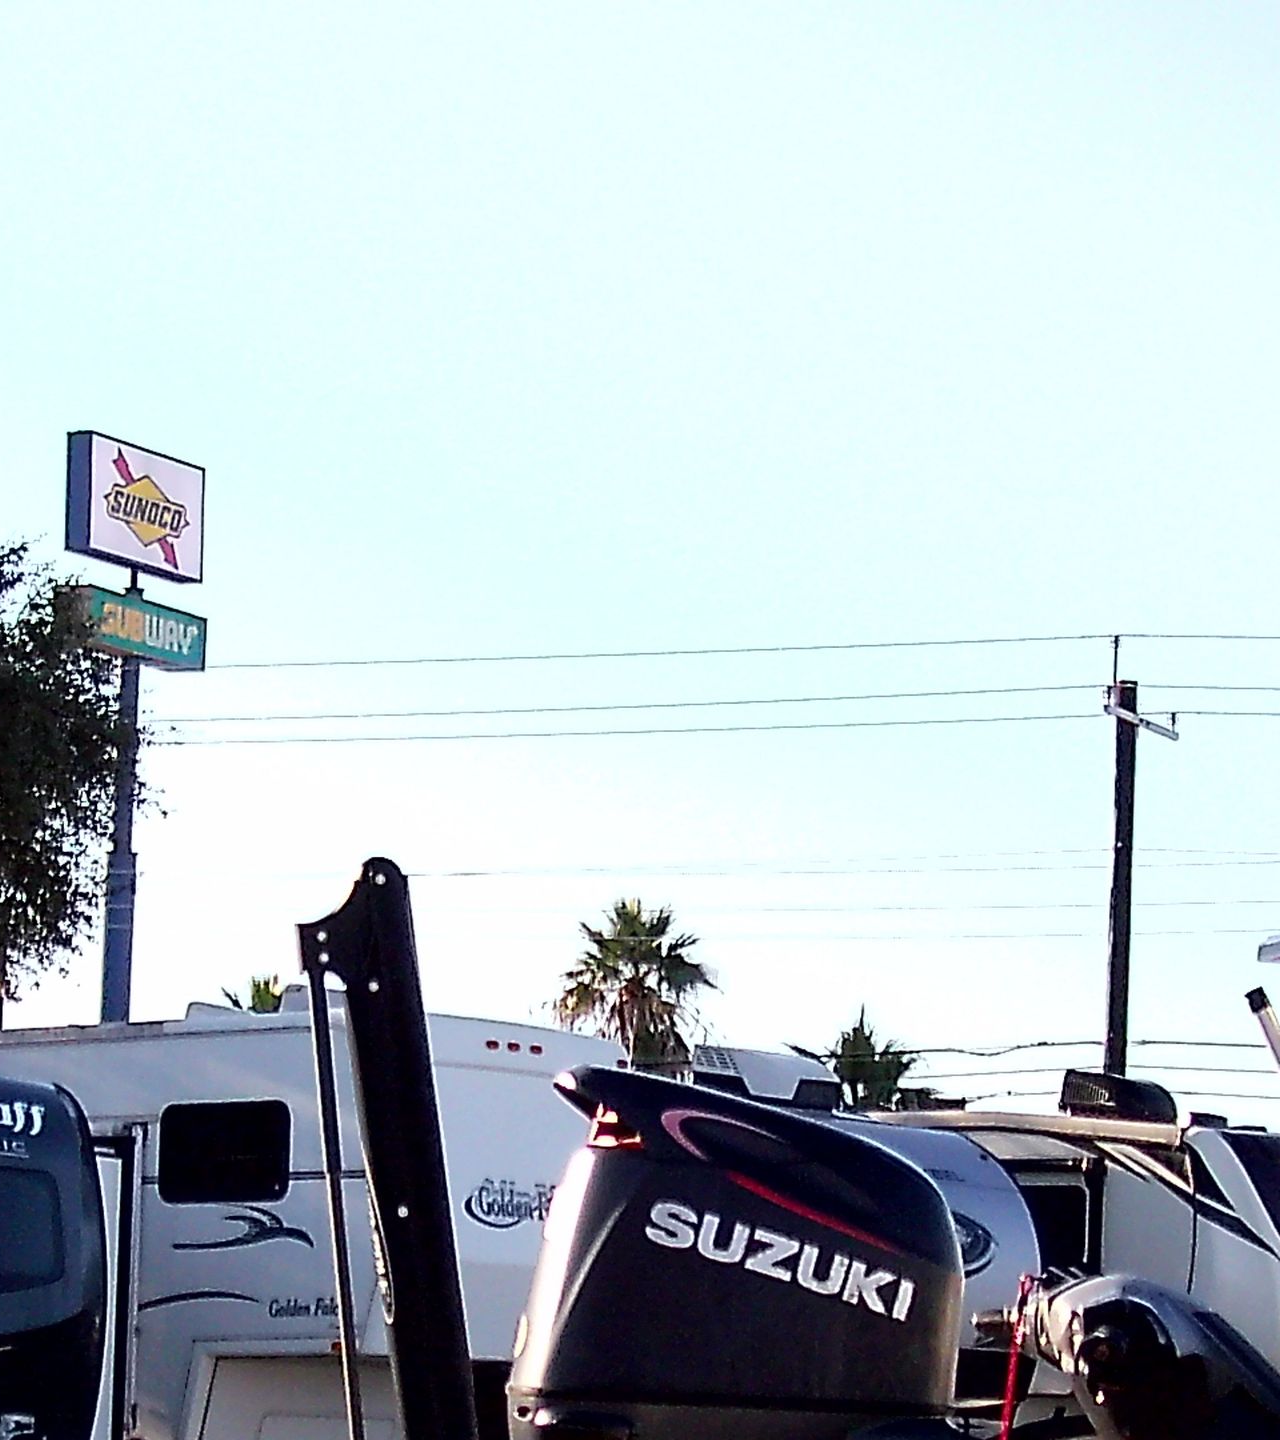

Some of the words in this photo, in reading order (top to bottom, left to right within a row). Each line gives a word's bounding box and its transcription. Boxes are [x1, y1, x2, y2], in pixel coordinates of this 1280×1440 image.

[111, 490, 183, 532] SUNOCO
[100, 602, 198, 655] SUBWAY
[645, 1200, 915, 1322] SUZUKI
[268, 1297, 310, 1318] Golden
[314, 1296, 339, 1317] Falc
